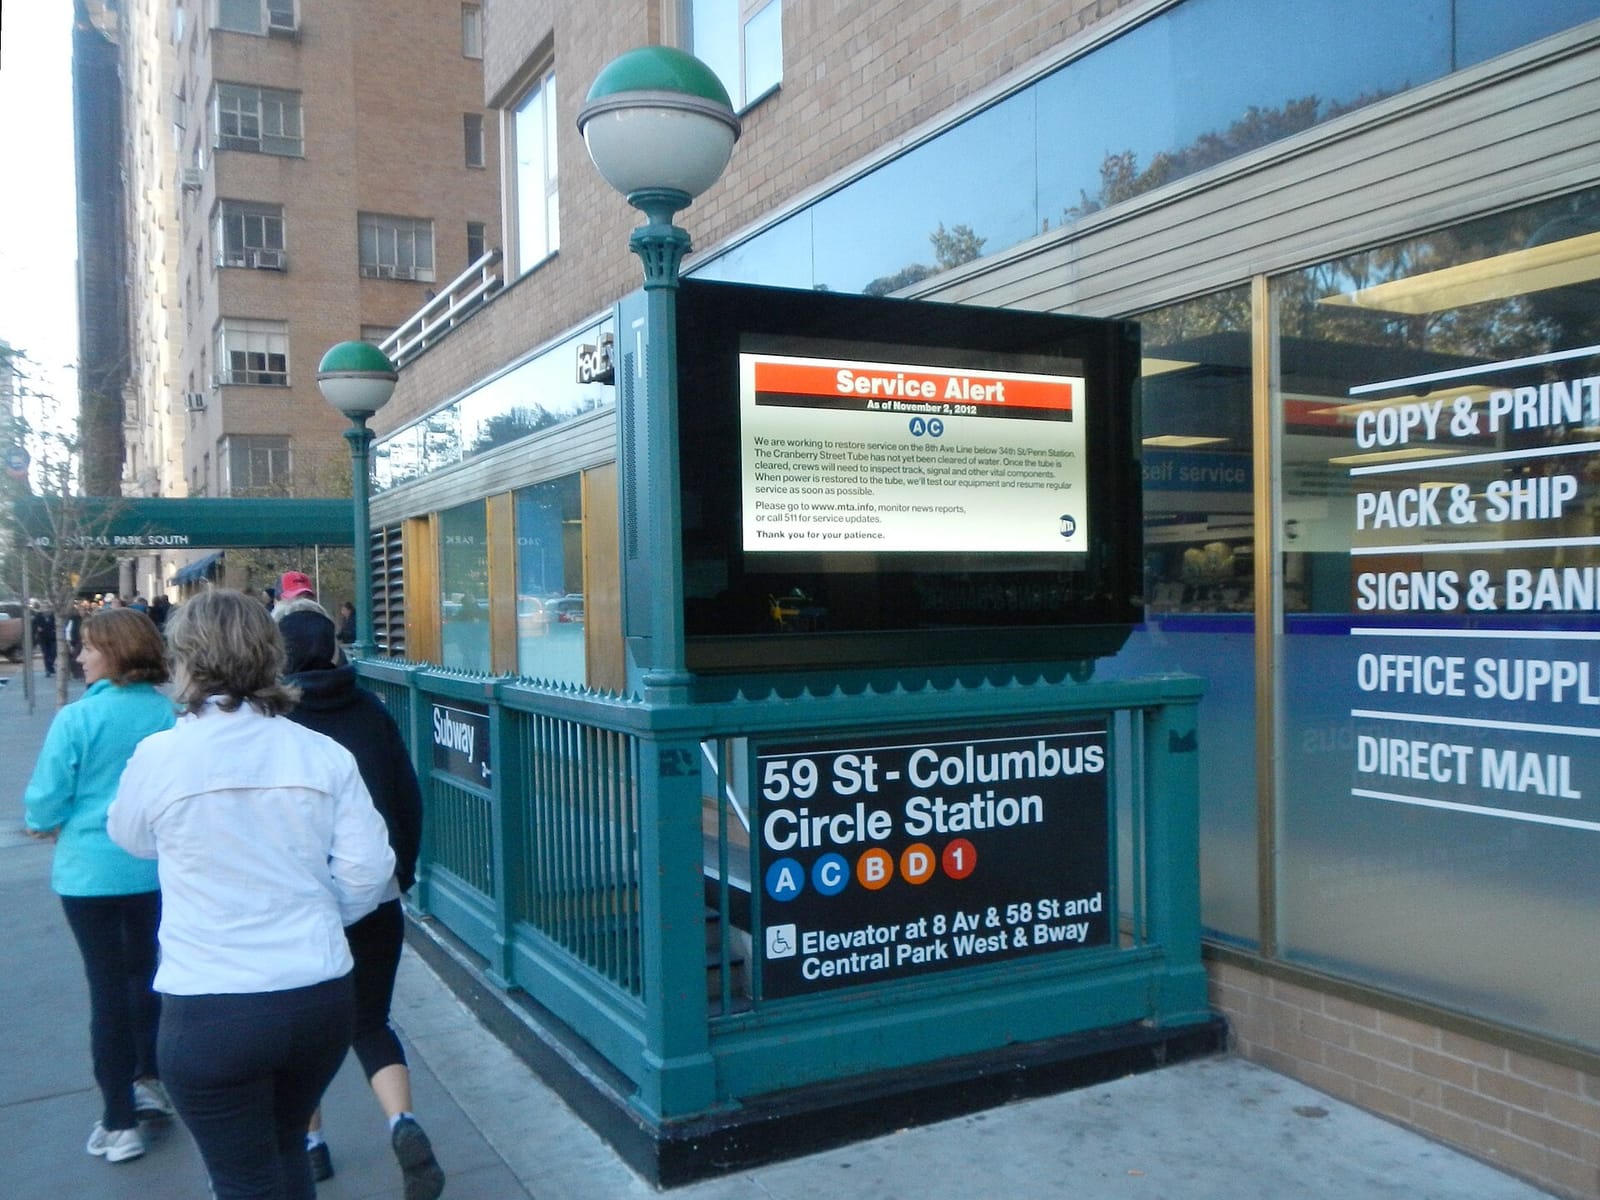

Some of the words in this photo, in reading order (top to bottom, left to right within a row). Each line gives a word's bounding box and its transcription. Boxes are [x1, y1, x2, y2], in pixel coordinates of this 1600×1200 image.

[836, 369, 937, 398] Service
[944, 377, 1006, 402] Alert
[866, 399, 880, 409] As
[881, 400, 892, 410] of
[893, 402, 941, 413] November
[942, 404, 953, 414] 2,
[954, 404, 977, 414] 2012
[1357, 400, 1440, 449] COPY
[1450, 395, 1478, 437] &
[1490, 377, 1600, 433] PRINT
[754, 437, 769, 446] We
[786, 439, 823, 449] working
[824, 440, 834, 448] to
[834, 441, 866, 450] restore
[867, 442, 897, 450] service
[910, 443, 924, 452] the
[925, 444, 938, 452] 8th
[939, 444, 955, 454] Ave
[956, 444, 972, 454] Line
[974, 446, 998, 454] below
[1047, 448, 1076, 458] Station.
[754, 448, 772, 458] The
[773, 449, 818, 460] Cranberry
[819, 451, 846, 460] Street
[848, 451, 868, 461] Tube
[870, 452, 886, 462] has
[886, 454, 901, 462] not
[902, 454, 915, 464] yet
[916, 455, 936, 464] been
[937, 456, 966, 465] cleared
[968, 456, 977, 465] of
[978, 458, 1001, 466] water.
[1002, 457, 1024, 466] Once
[1024, 458, 1036, 468] the
[1038, 459, 1054, 468] tube
[1056, 460, 1062, 468] is
[754, 461, 791, 472] cleared,
[792, 463, 820, 471] crews
[820, 462, 835, 472] will
[836, 464, 858, 472] need
[860, 464, 868, 473] to
[870, 464, 900, 475] inspect
[902, 466, 926, 476] track,
[926, 466, 950, 476] signal
[951, 468, 966, 476] and
[968, 468, 988, 476] other
[990, 468, 1006, 477] vital
[1006, 470, 1056, 479] components.
[754, 472, 782, 482] When
[782, 474, 811, 483] power
[812, 474, 820, 482] is
[821, 474, 858, 484] restored
[860, 476, 868, 484] to
[870, 476, 884, 484] the
[884, 476, 906, 486] tube,
[906, 478, 926, 486] we'll
[926, 478, 942, 486] test
[958, 480, 1000, 488] equipment
[1001, 480, 1016, 488] and
[1046, 481, 1072, 491] regular
[1180, 462, 1245, 482] service
[755, 485, 788, 494] service
[789, 486, 800, 494] as
[800, 486, 824, 495] soon
[836, 487, 874, 496] possible.
[1357, 486, 1441, 530] PACK
[1448, 482, 1477, 524] &
[1486, 474, 1578, 523] SHIP
[755, 500, 786, 510] Please
[787, 503, 799, 512] go
[800, 502, 810, 511] to
[811, 502, 877, 513] www.mta.info,
[878, 504, 910, 512] monitor
[934, 505, 966, 514] reports,
[755, 514, 765, 522] or
[767, 513, 783, 522] call
[784, 513, 798, 522] 511
[798, 514, 811, 522] for
[812, 514, 844, 523] service
[845, 514, 882, 524] updates.
[114, 536, 144, 546] PARK
[148, 535, 188, 545] SOUTH
[756, 530, 785, 539] Thank
[788, 532, 804, 540] you
[807, 530, 819, 539] for
[822, 532, 841, 540] your
[844, 531, 885, 540] patience.
[1357, 570, 1459, 612] SIGNS
[1467, 570, 1497, 611] &
[1506, 567, 1600, 610] BAN
[1358, 653, 1465, 697] OFFICE
[1474, 658, 1600, 705] SUPPL
[433, 707, 474, 764] Subway
[762, 759, 818, 801] 59
[832, 754, 878, 794] St
[908, 740, 1104, 788] Columbus
[1358, 736, 1473, 785] DIRECT
[1482, 750, 1582, 799] MAIL
[764, 802, 892, 851] Circle
[904, 791, 1043, 837] Station
[802, 926, 900, 955] Elevator
[905, 919, 925, 938] at
[933, 915, 947, 936] 8
[952, 911, 980, 932] Av
[986, 907, 1001, 928] &
[1006, 903, 1032, 924] 58
[1038, 898, 1060, 920] St
[1064, 892, 1102, 916] and
[802, 948, 890, 981] Central
[896, 938, 948, 966] Park
[956, 930, 1007, 957] West
[1012, 927, 1028, 948] &
[1034, 922, 1089, 945] Bway
